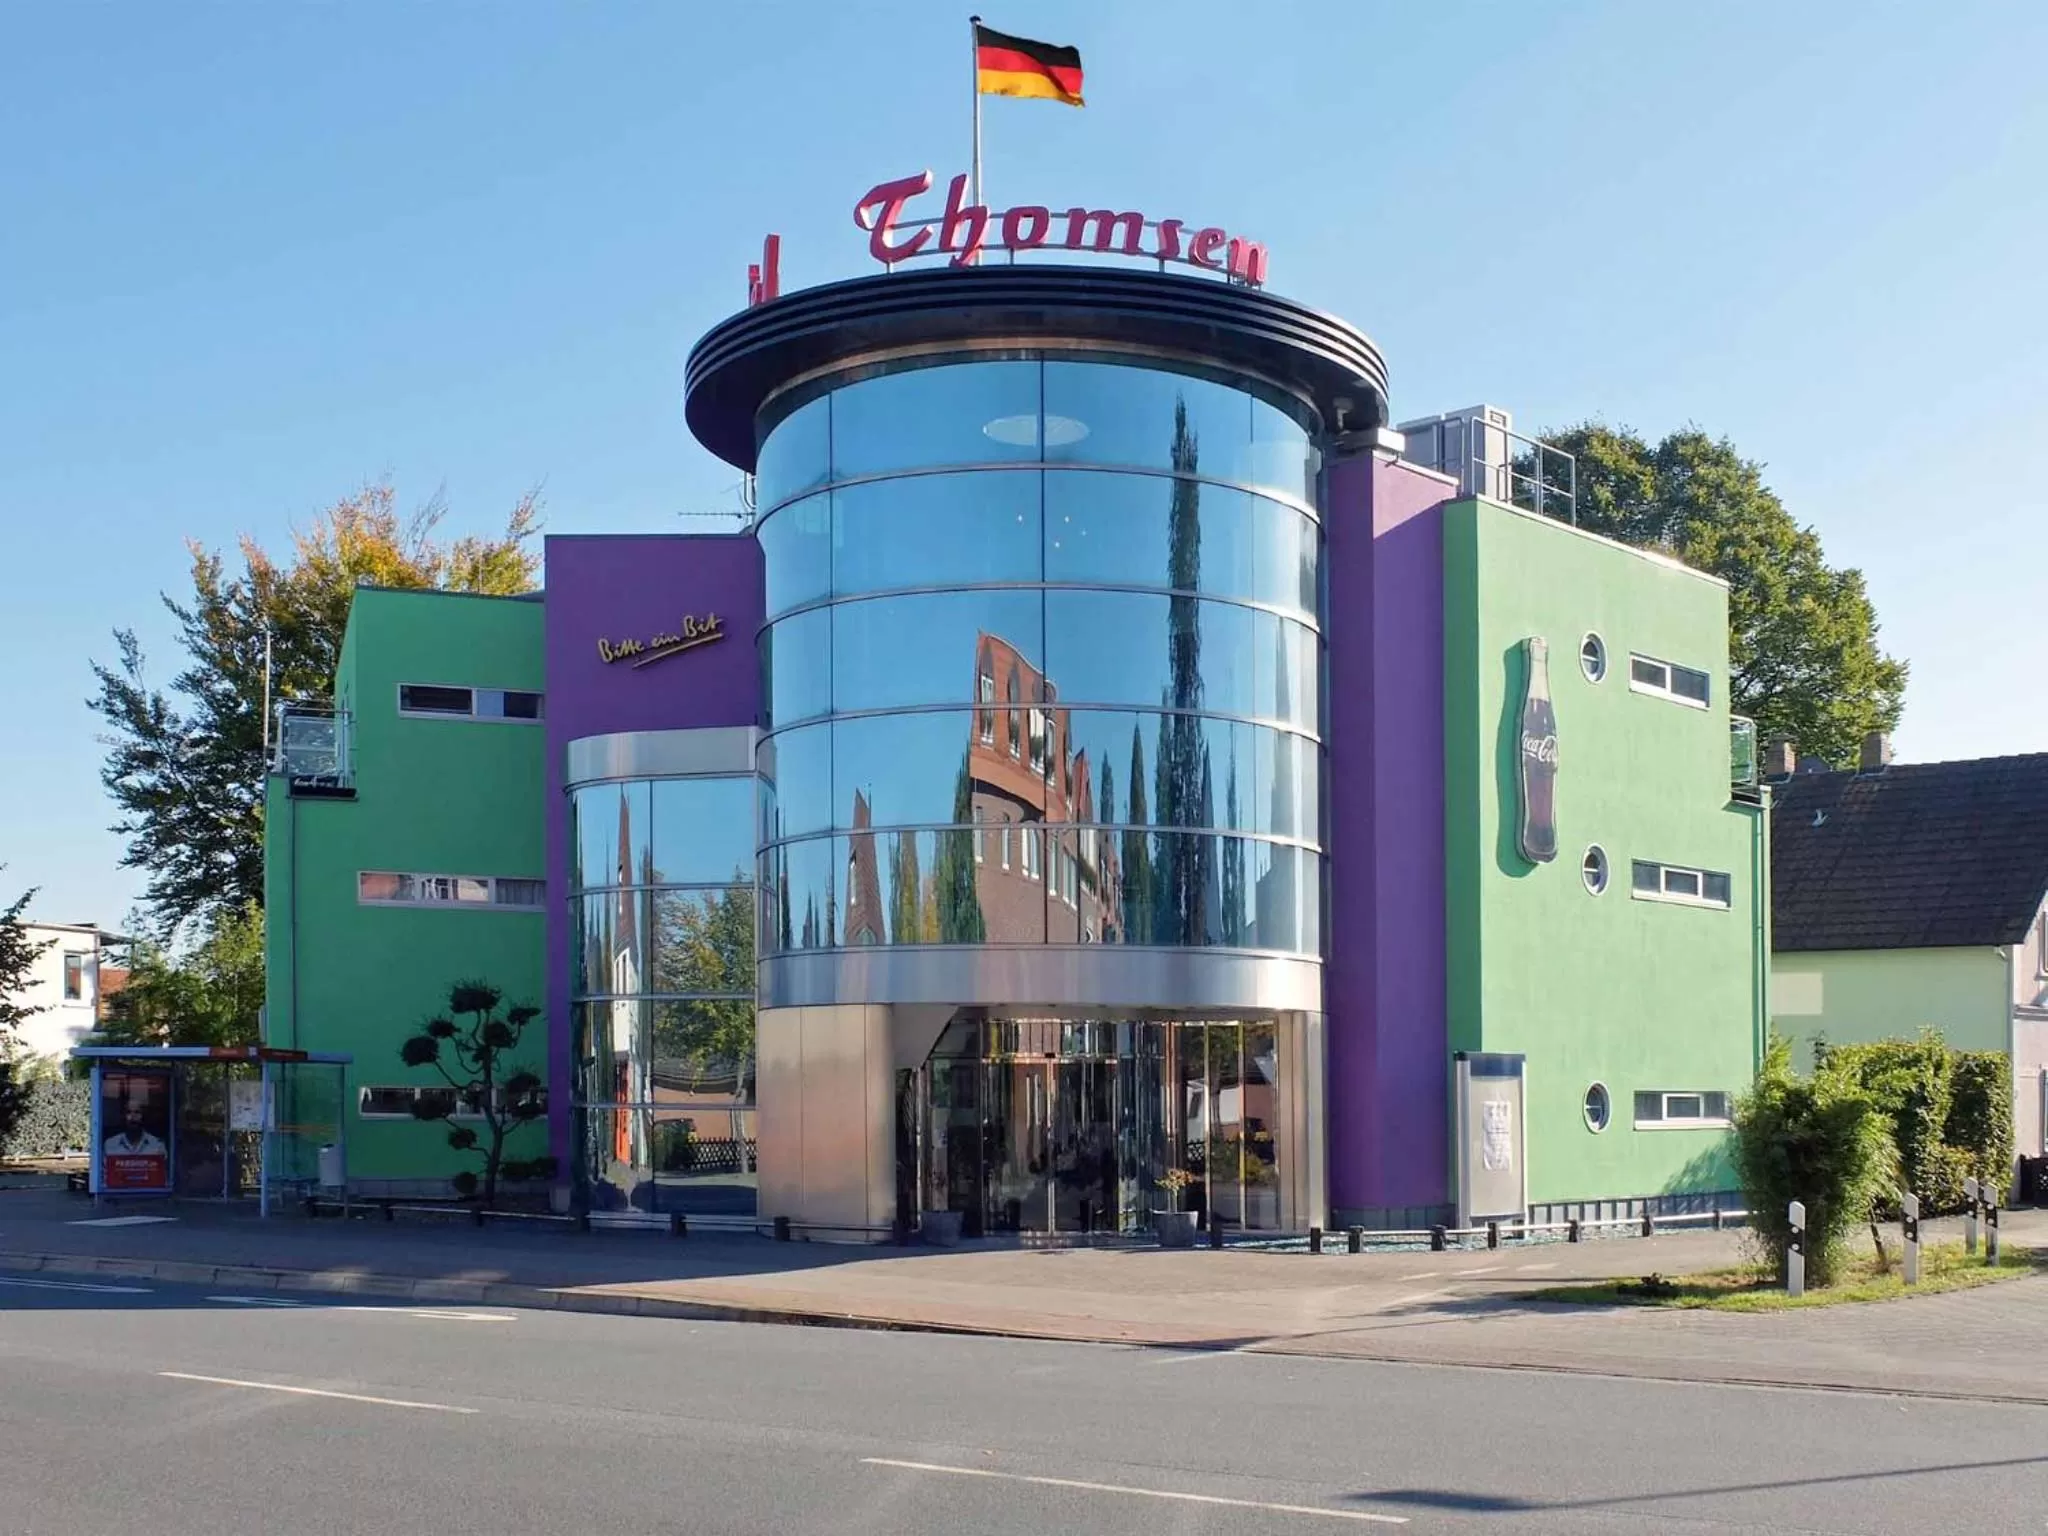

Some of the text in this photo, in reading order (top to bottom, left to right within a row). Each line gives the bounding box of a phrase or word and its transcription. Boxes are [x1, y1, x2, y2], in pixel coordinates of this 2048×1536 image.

[854, 169, 1269, 286] Thomsen
[598, 612, 724, 663] Bitte ein Bit
